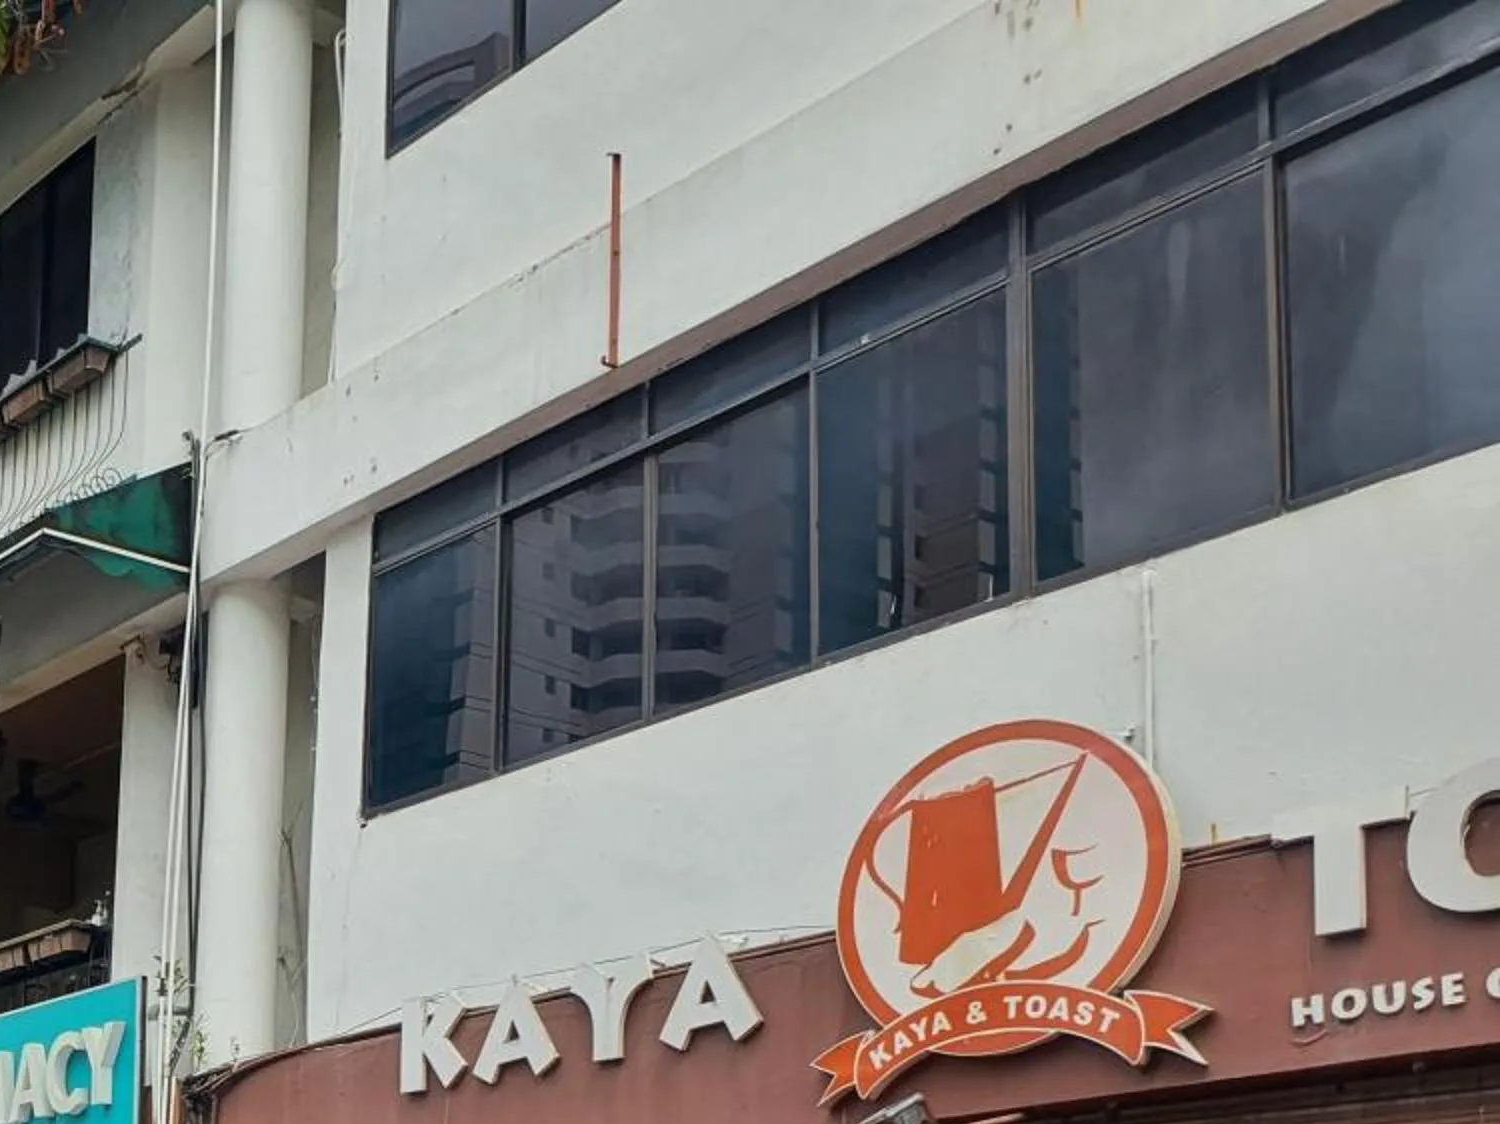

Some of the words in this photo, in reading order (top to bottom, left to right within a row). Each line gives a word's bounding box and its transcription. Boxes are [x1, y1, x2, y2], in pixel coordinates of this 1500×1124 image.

[1270, 757, 1500, 937] TO
[399, 932, 764, 1096] KAYA
[867, 1011, 953, 1071] KAYA
[966, 1001, 987, 1025] &
[1003, 994, 1121, 1034] TOAST
[1291, 971, 1468, 1028] HOUSE
